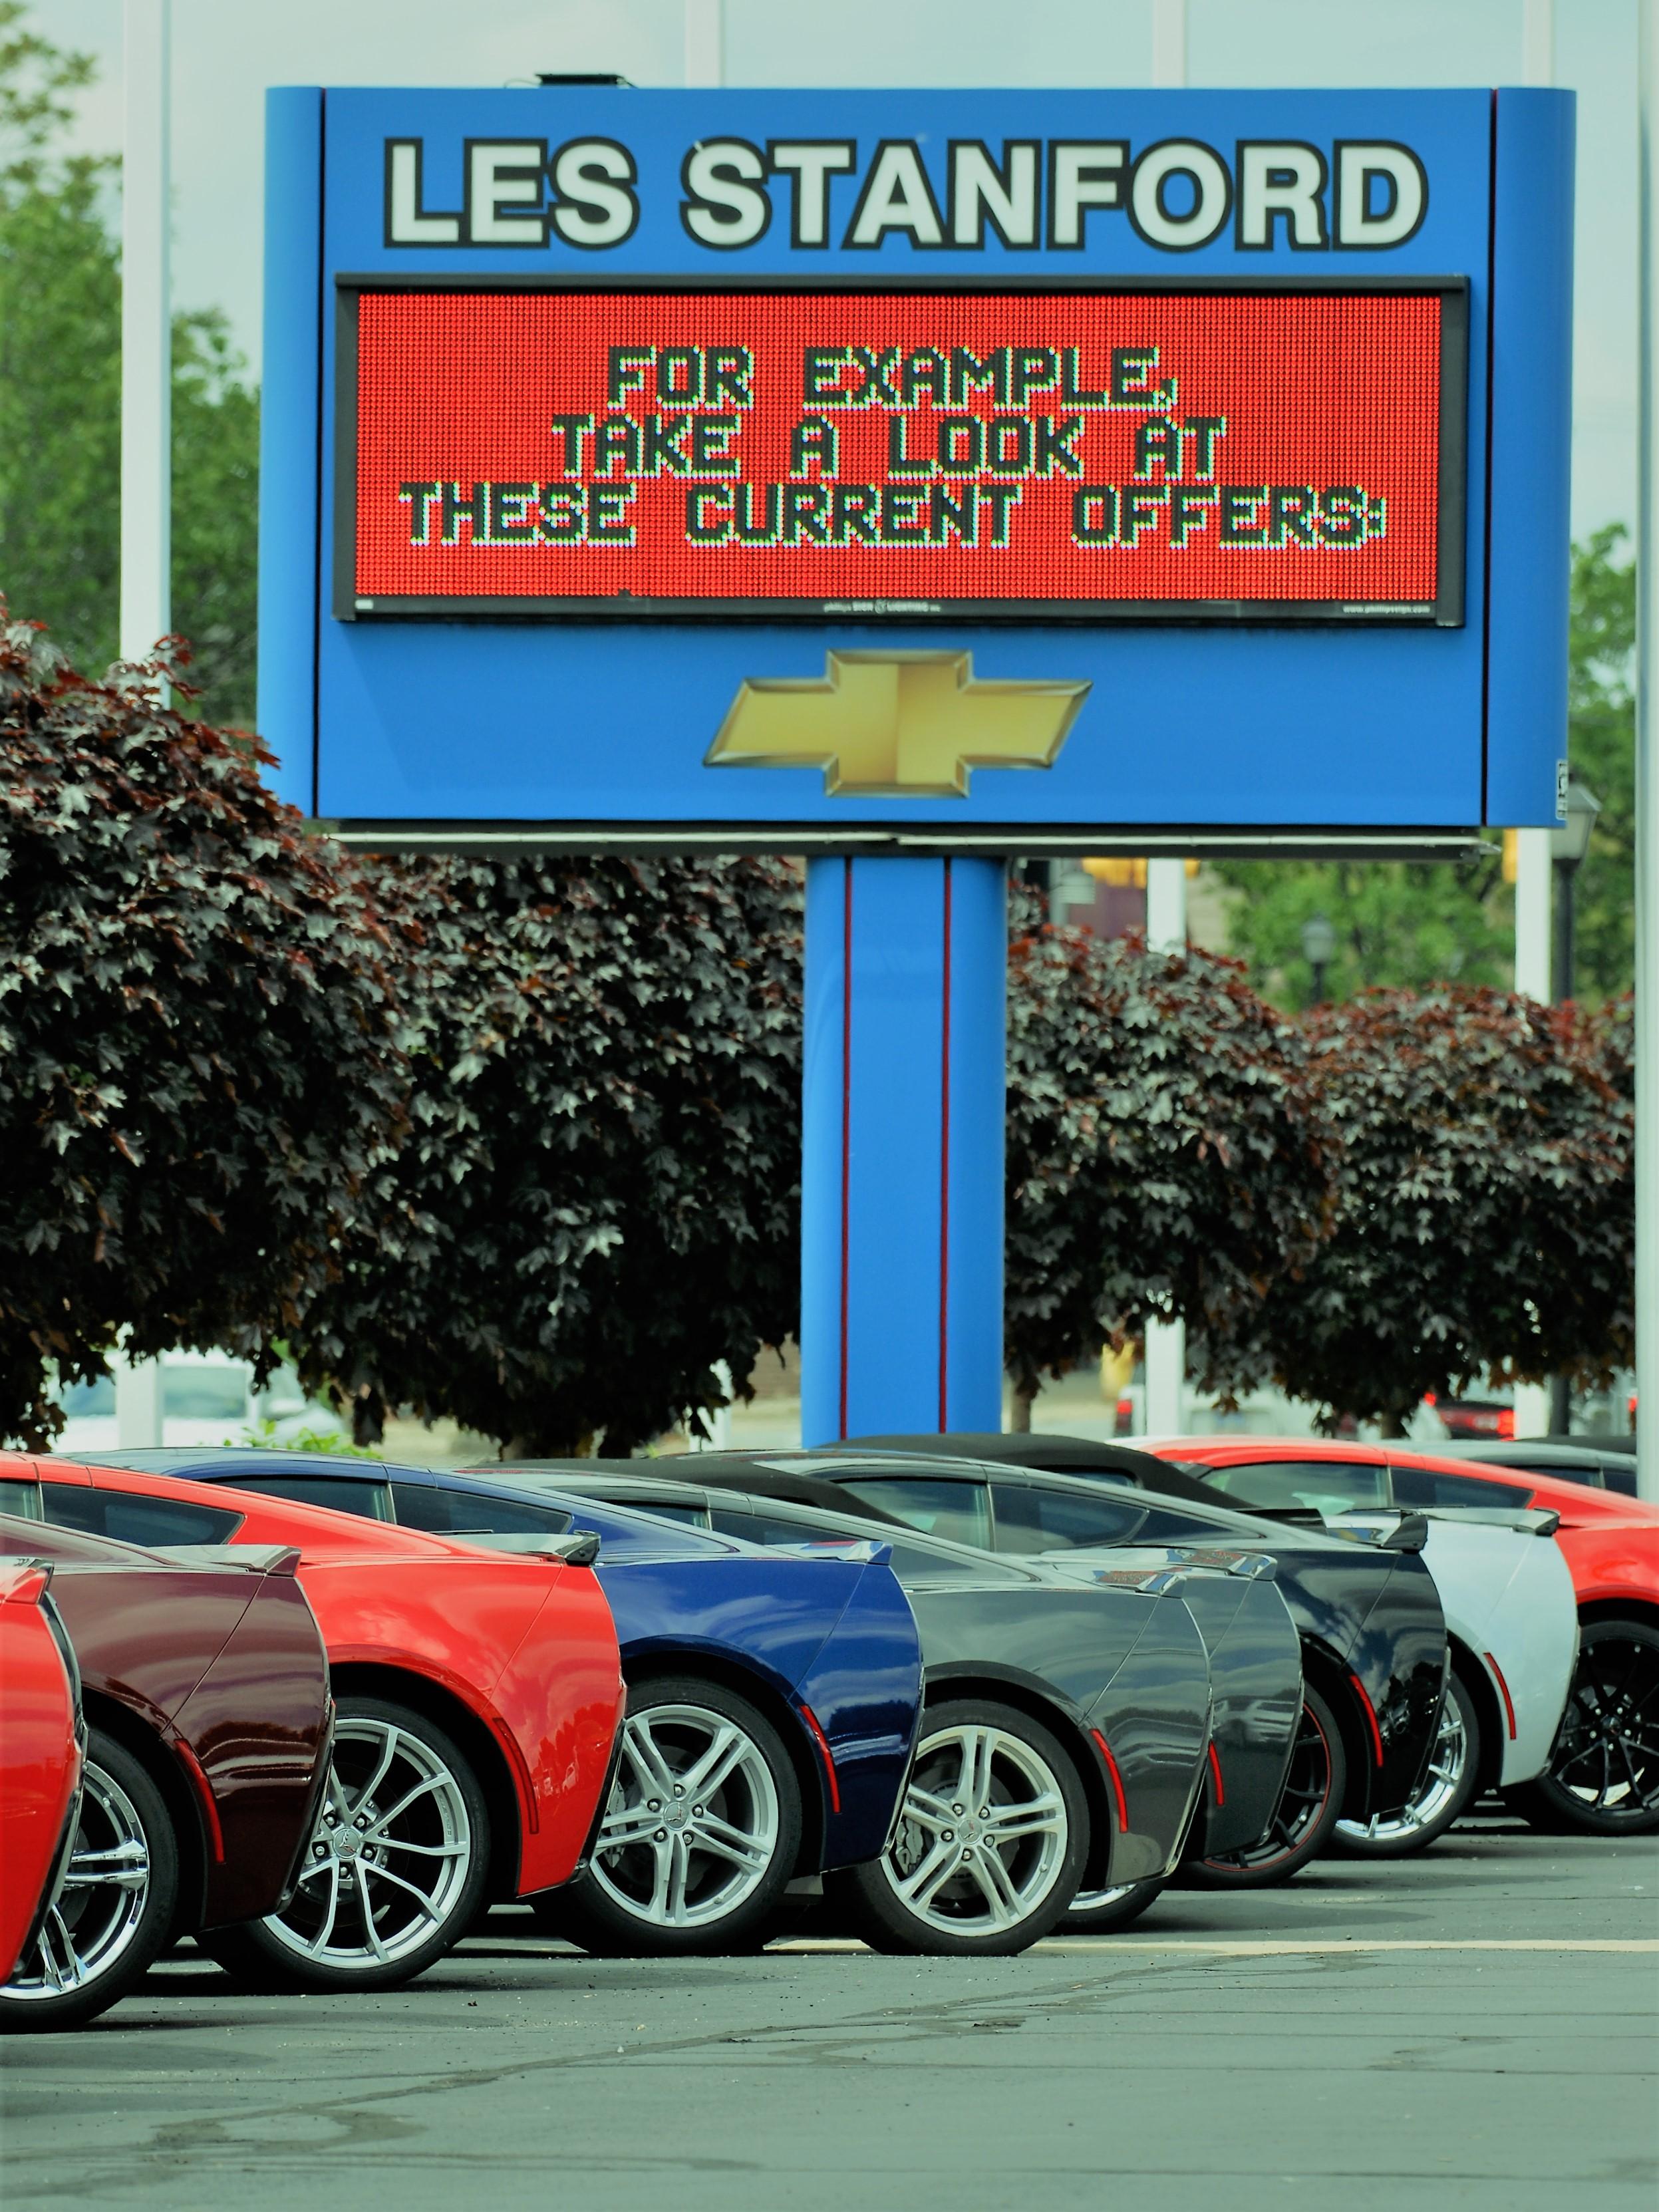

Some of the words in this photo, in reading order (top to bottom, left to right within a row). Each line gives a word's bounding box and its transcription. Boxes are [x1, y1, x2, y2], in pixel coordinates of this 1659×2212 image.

[384, 136, 641, 251] LES
[680, 136, 1429, 253] STANFORD
[607, 346, 755, 411] FOR
[802, 346, 1179, 412] EXAMPLE,
[551, 414, 742, 479] TAKE
[789, 414, 841, 479] A
[888, 414, 1086, 480] LOOK
[1133, 415, 1227, 481] AT
[398, 482, 638, 548] THESE
[685, 482, 1024, 549] CURRENT
